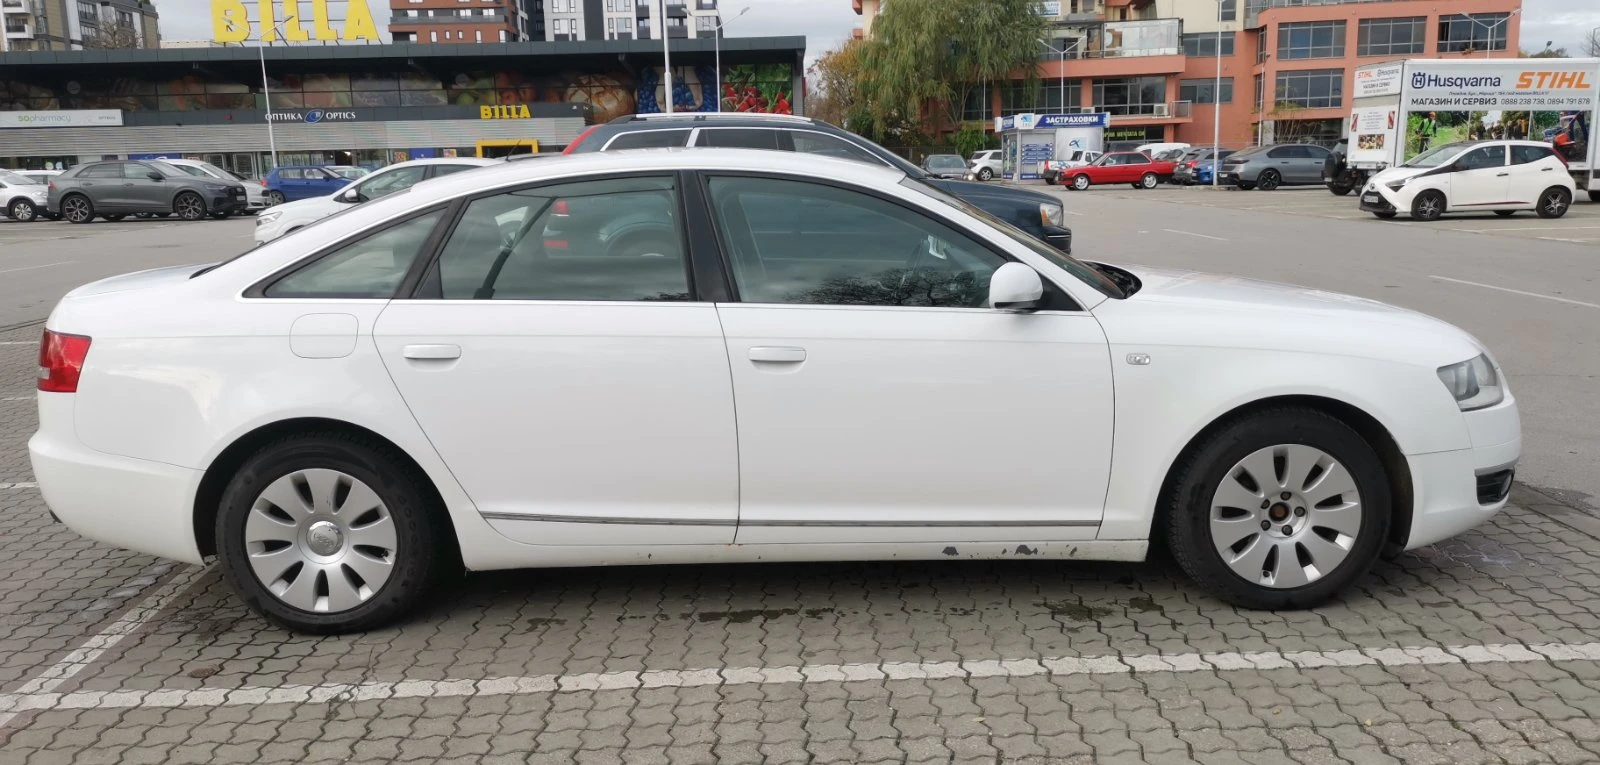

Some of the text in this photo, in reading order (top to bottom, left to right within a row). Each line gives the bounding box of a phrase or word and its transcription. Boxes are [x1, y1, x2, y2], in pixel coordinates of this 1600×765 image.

[211, 0, 379, 42] BILLA
[1427, 74, 1501, 89] Husqvarna
[1516, 72, 1590, 89] STIHL
[1411, 97, 1452, 105] МАГАЗИН
[1454, 97, 1460, 105] И
[1462, 97, 1497, 105] СЕРВИЗ
[326, 111, 356, 120] OPTICS
[481, 104, 531, 119] BILLA
[18, 113, 71, 123] sopharmacy
[265, 113, 303, 121] ОПТИКА
[1045, 115, 1098, 124] ЗАСТРАХОВКИ
